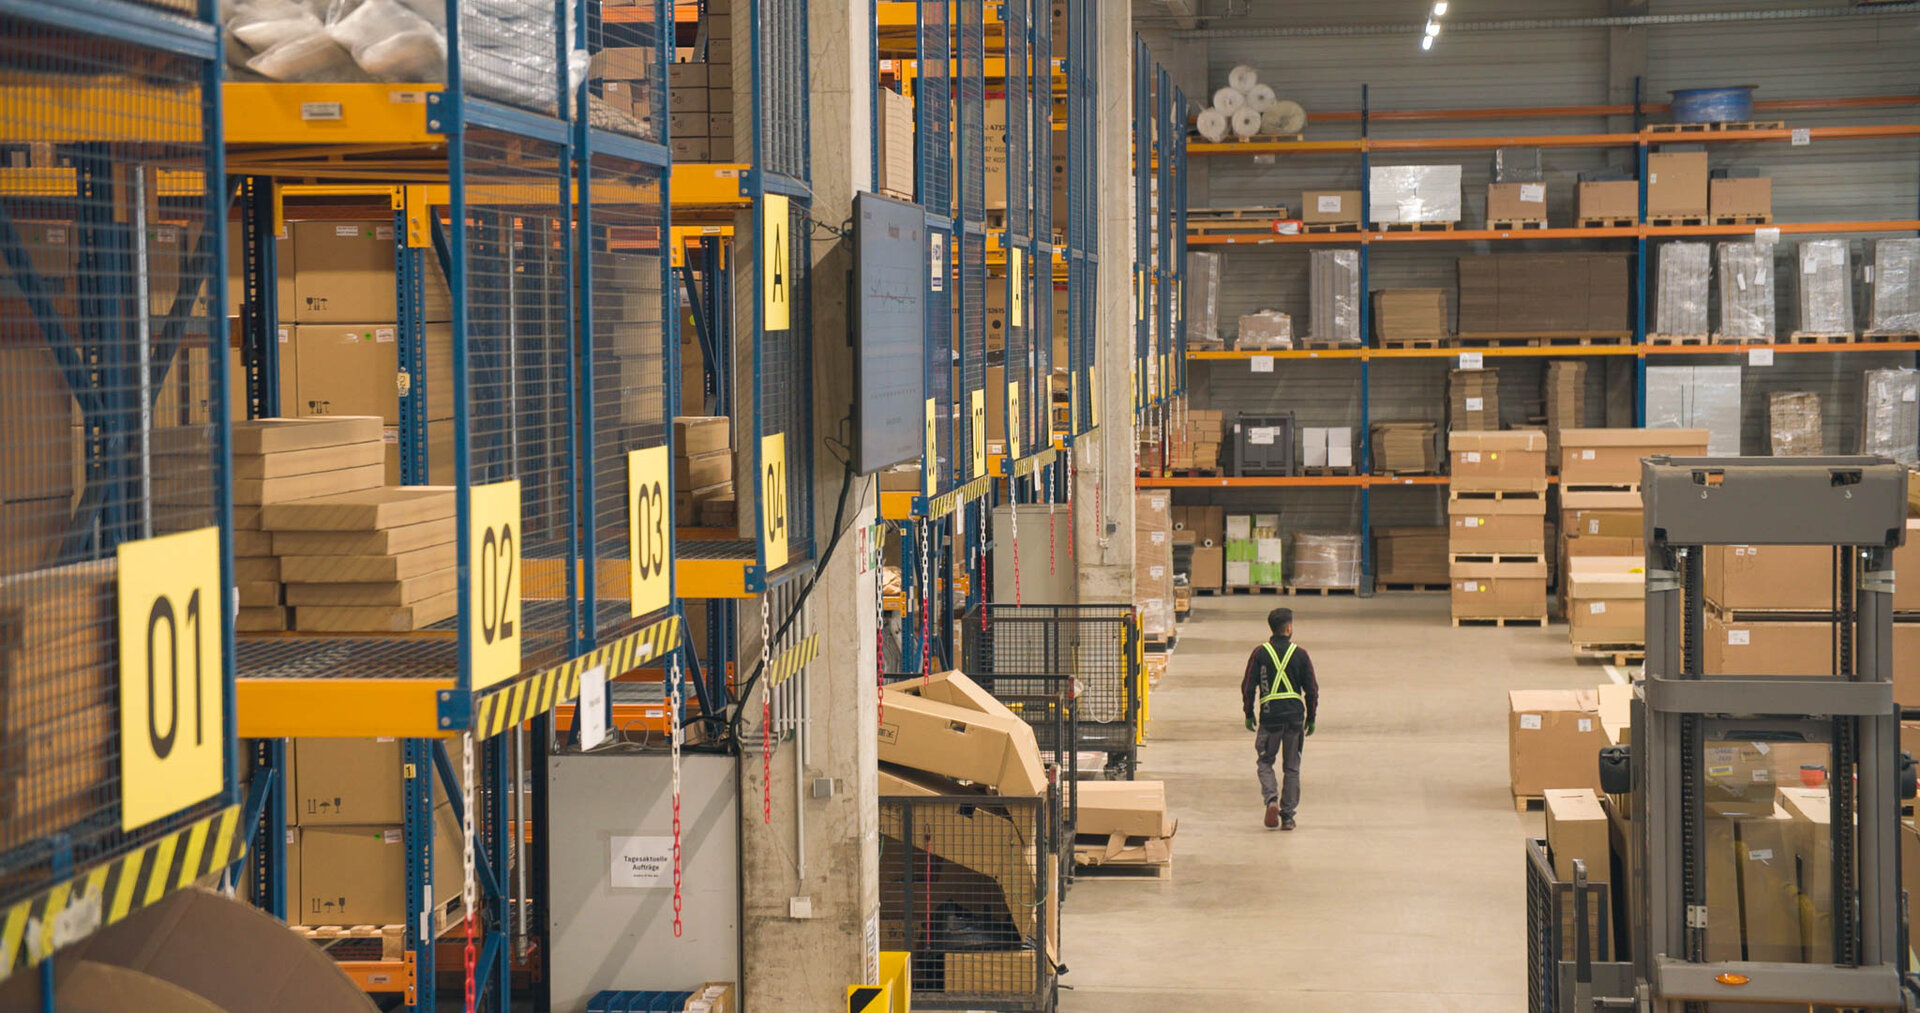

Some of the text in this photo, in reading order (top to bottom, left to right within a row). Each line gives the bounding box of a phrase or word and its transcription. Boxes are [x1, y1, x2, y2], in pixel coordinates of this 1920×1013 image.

[773, 224, 785, 303] A
[975, 408, 983, 459] 07
[639, 482, 663, 580] 03
[767, 461, 784, 543] 04
[482, 523, 513, 645] 02
[147, 588, 202, 760] 01
[624, 855, 668, 863] Tagesaktuelle
[632, 864, 659, 872] Aufträge
